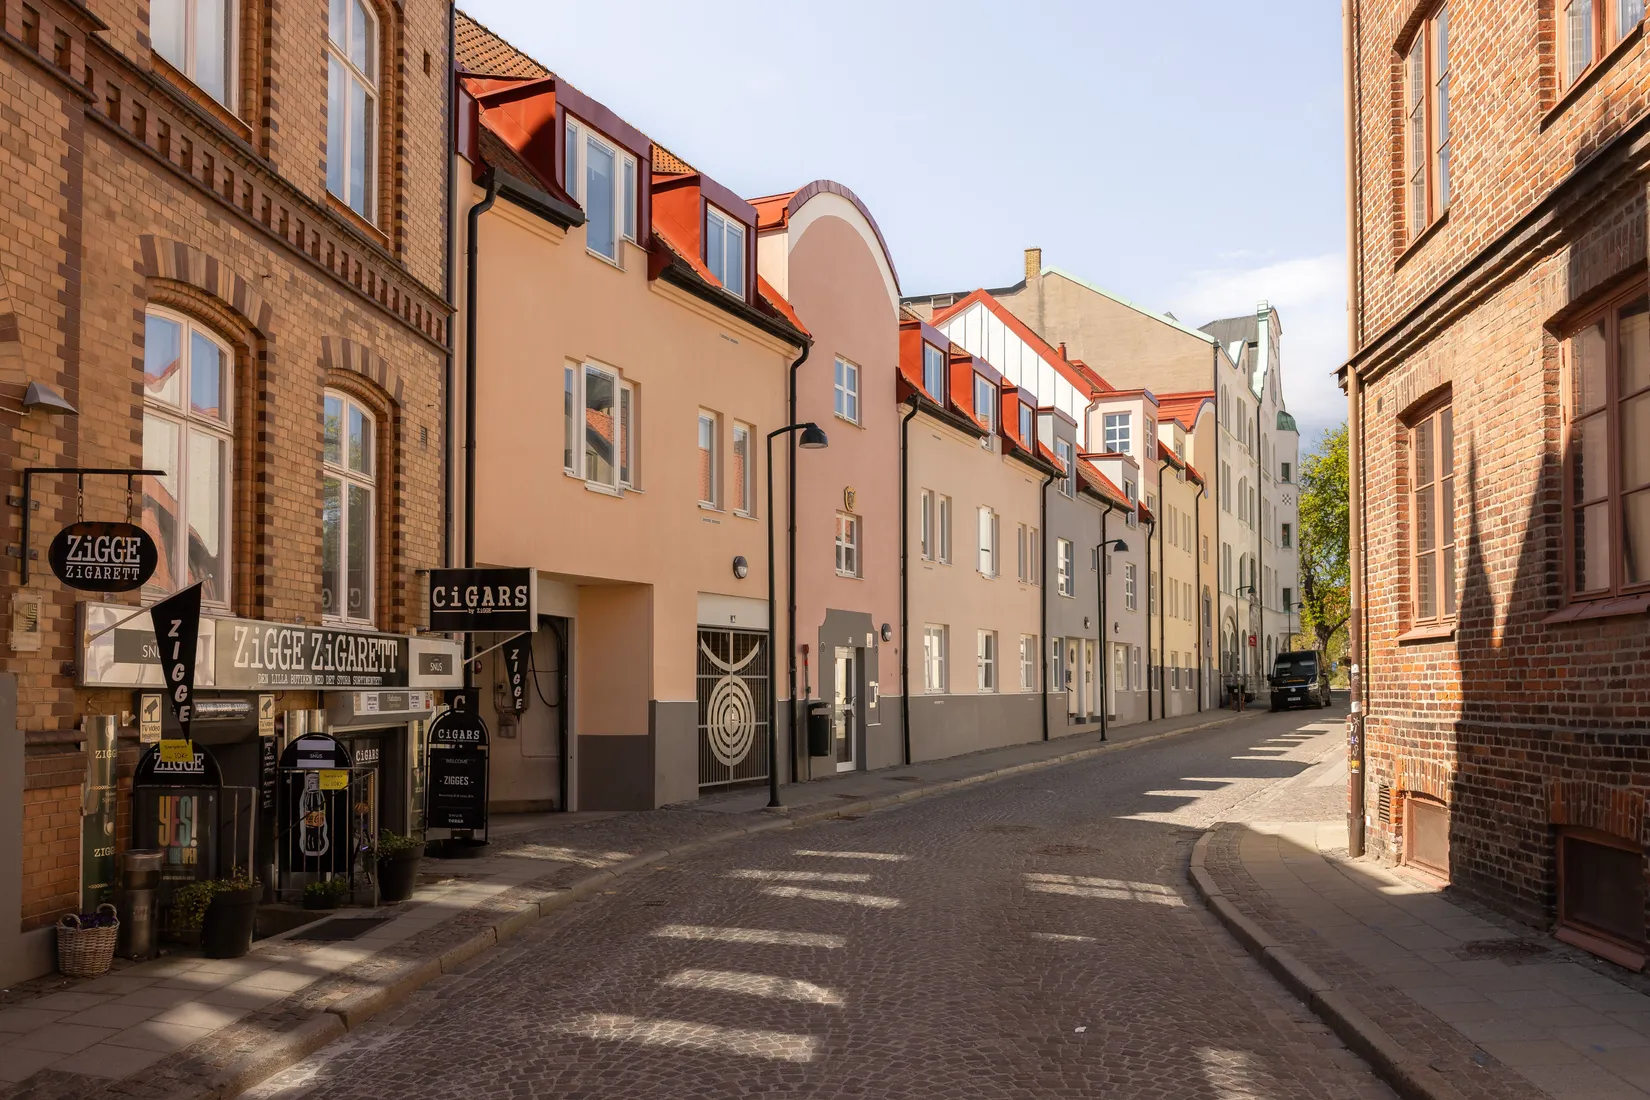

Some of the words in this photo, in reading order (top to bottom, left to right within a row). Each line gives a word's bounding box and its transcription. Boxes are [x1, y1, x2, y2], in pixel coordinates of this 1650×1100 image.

[66, 535, 141, 563] ZiGGE
[65, 565, 140, 580] ZiGARETT
[432, 585, 528, 607] CiGARS
[234, 626, 305, 670] ZiGGE
[311, 632, 398, 673] ZiGARETT
[168, 619, 191, 723] ZIGGE
[430, 662, 443, 672] SNUS
[258, 673, 269, 684] DEN
[271, 673, 288, 684] LILLA
[511, 649, 523, 709] ZIGGE
[437, 729, 480, 740] CiGARS
[95, 749, 118, 759] ZIGG
[443, 775, 469, 786] ZIGGES
[158, 795, 198, 847] YES!
[94, 847, 115, 858] ZIGG
